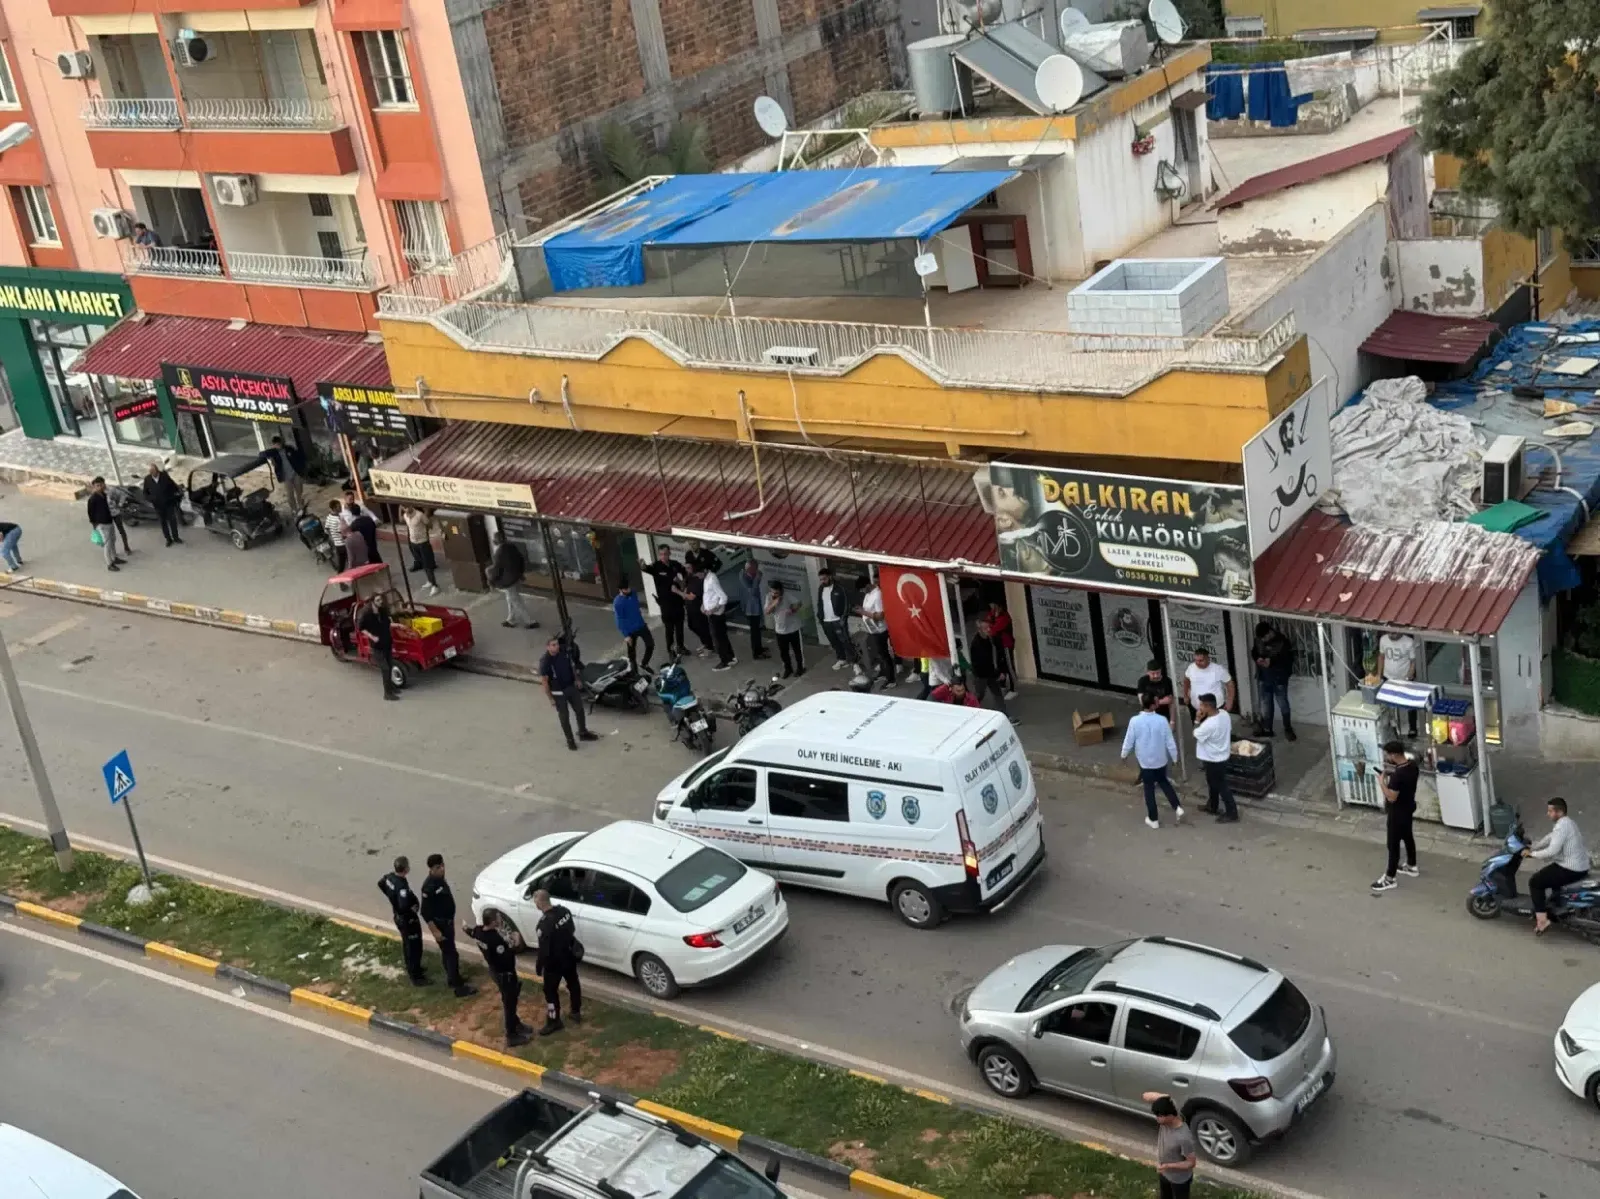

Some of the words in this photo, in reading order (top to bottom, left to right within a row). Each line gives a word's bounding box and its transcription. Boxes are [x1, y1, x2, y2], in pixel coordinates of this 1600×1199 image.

[55, 289, 123, 317] MARKET
[200, 374, 230, 393] ASYA
[210, 394, 235, 408] 0531
[235, 398, 257, 411] 973
[258, 401, 274, 413] 00
[333, 386, 367, 404] ARSLAN
[1042, 478, 1193, 516] DALKIRAN
[1082, 503, 1124, 523] Erkek
[1095, 520, 1203, 550] KUAFÖRÜ
[1107, 547, 1131, 556] LAZER
[1143, 551, 1186, 562] EPİLASYON
[1130, 558, 1164, 568] MERKEZİ
[797, 748, 818, 759] OLAY
[819, 750, 838, 762] YERİ
[840, 752, 881, 769] İNCELEME
[964, 766, 979, 783] OLAY
